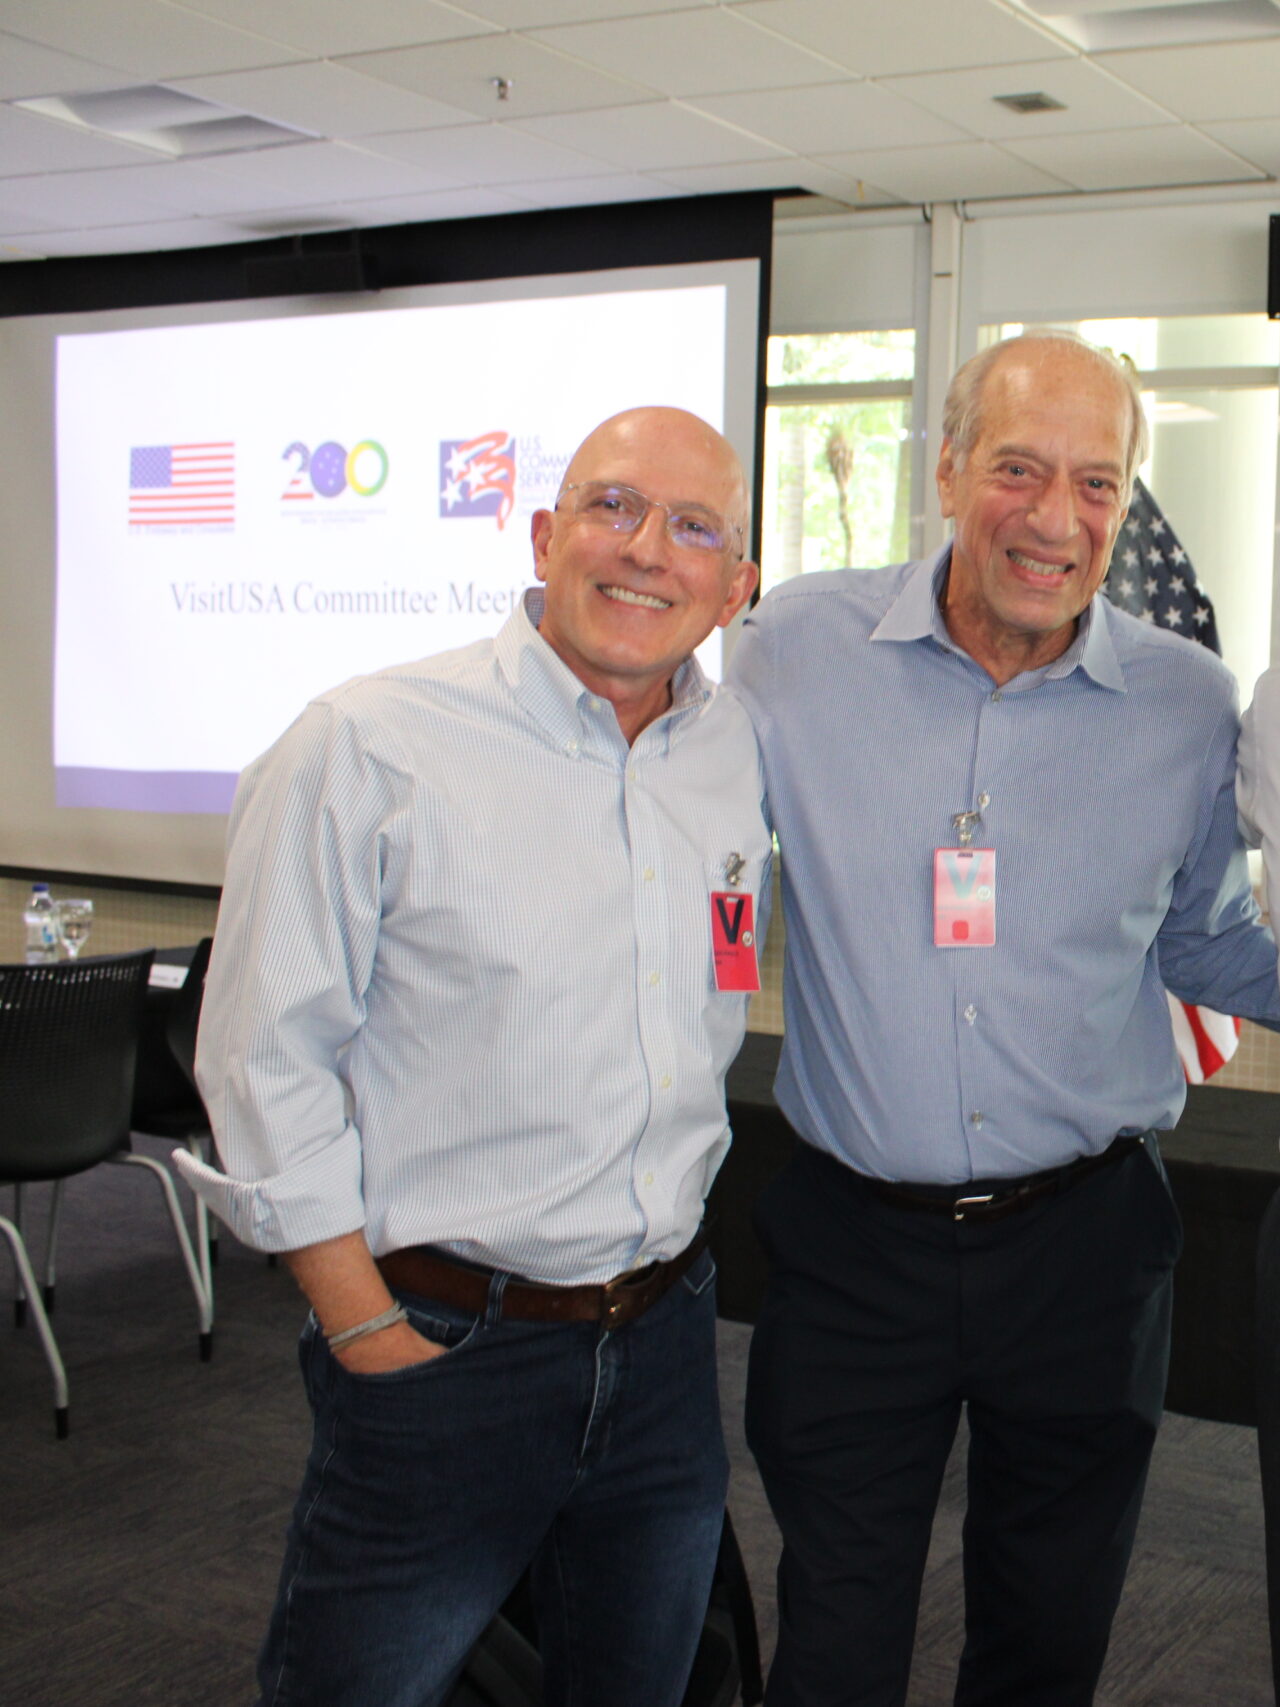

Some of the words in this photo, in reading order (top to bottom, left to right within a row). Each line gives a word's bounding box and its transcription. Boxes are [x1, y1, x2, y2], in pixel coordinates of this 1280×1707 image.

[281, 438, 389, 500] 200
[519, 453, 575, 469] COMM
[170, 580, 285, 613] VisitUSA
[293, 580, 439, 613] Committee
[448, 580, 526, 614] Meet
[943, 852, 983, 899] V
[716, 898, 745, 944] V
